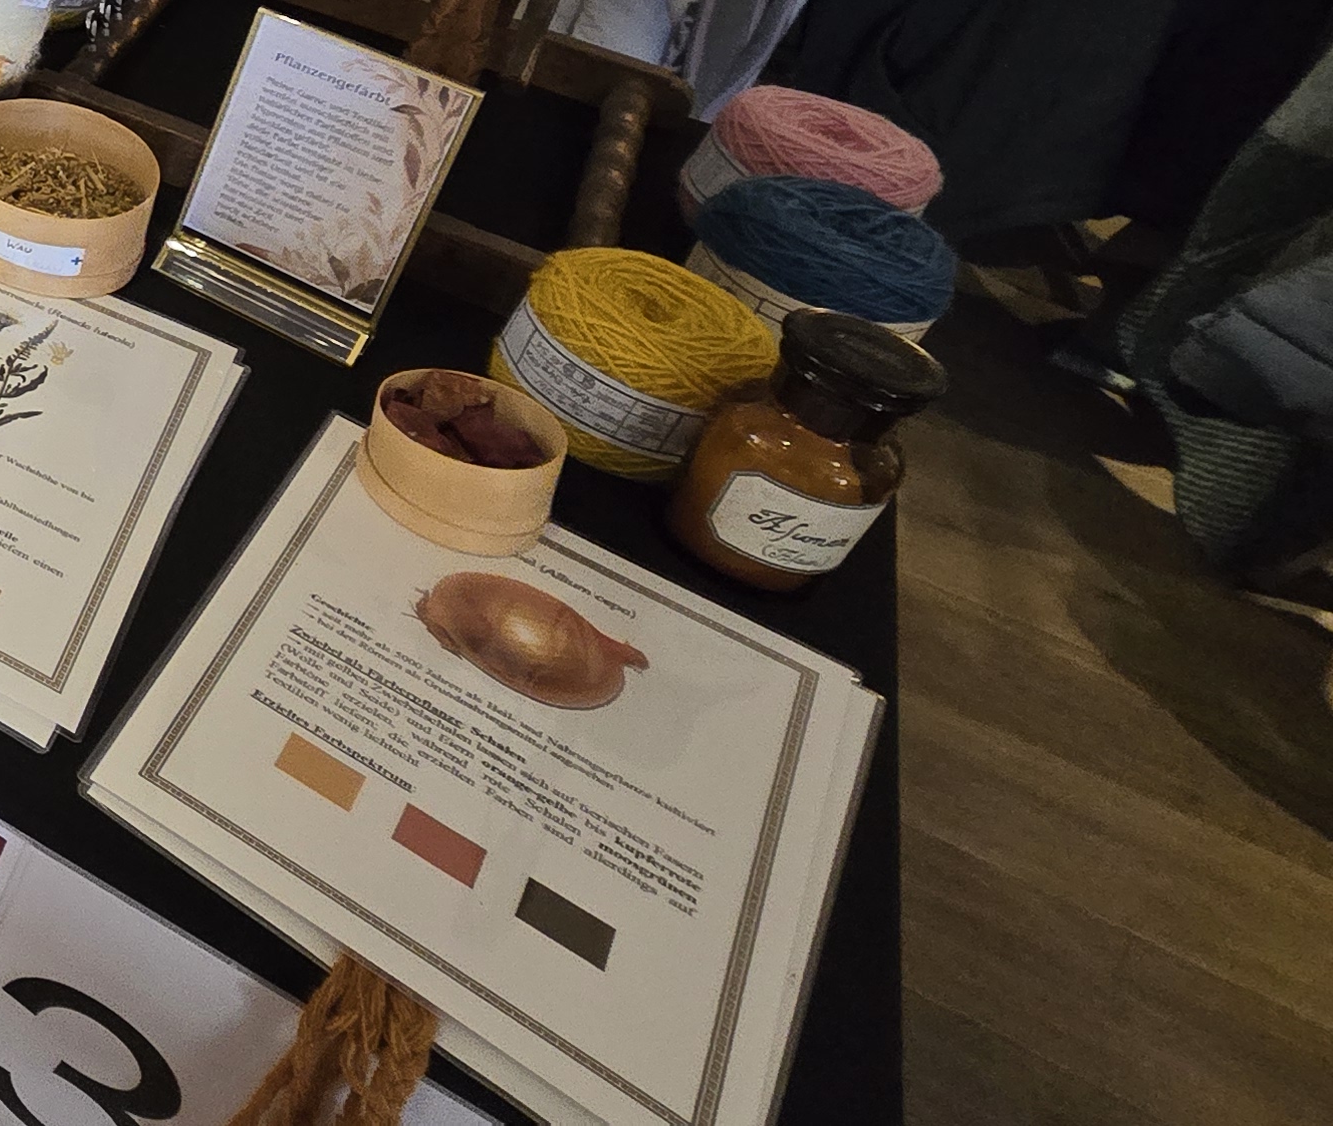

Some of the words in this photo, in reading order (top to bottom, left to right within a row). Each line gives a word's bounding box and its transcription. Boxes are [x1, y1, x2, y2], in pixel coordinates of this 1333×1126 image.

[272, 50, 394, 109] Pflanzengefärbt
[7, 239, 32, 254] WAU
[539, 563, 592, 597] (Allium
[592, 591, 636, 621] cepa)
[249, 687, 312, 730] Erzieltes
[309, 723, 419, 795] Farbspektrum:
[314, 700, 362, 734] wenig
[467, 724, 528, 765] Schalen
[266, 659, 330, 701] Farbstoff
[415, 746, 477, 788] erzielten
[483, 785, 536, 823] Farben
[541, 819, 575, 846] sind
[581, 844, 659, 898] allerdings
[272, 650, 331, 688] Farbtöne
[339, 689, 398, 728] erzielen,
[409, 729, 470, 770] während
[523, 796, 583, 837] Schalen
[596, 839, 698, 906] moosgrünen
[277, 641, 325, 673] (Wolle
[356, 686, 402, 719] Seide)
[478, 758, 579, 822] orange-gelbe
[612, 834, 702, 894] kupferrote
[325, 657, 370, 688] gelben
[369, 681, 474, 746] Zwiebelschalen
[576, 801, 651, 850] tierischen
[651, 843, 705, 882] Fasern
